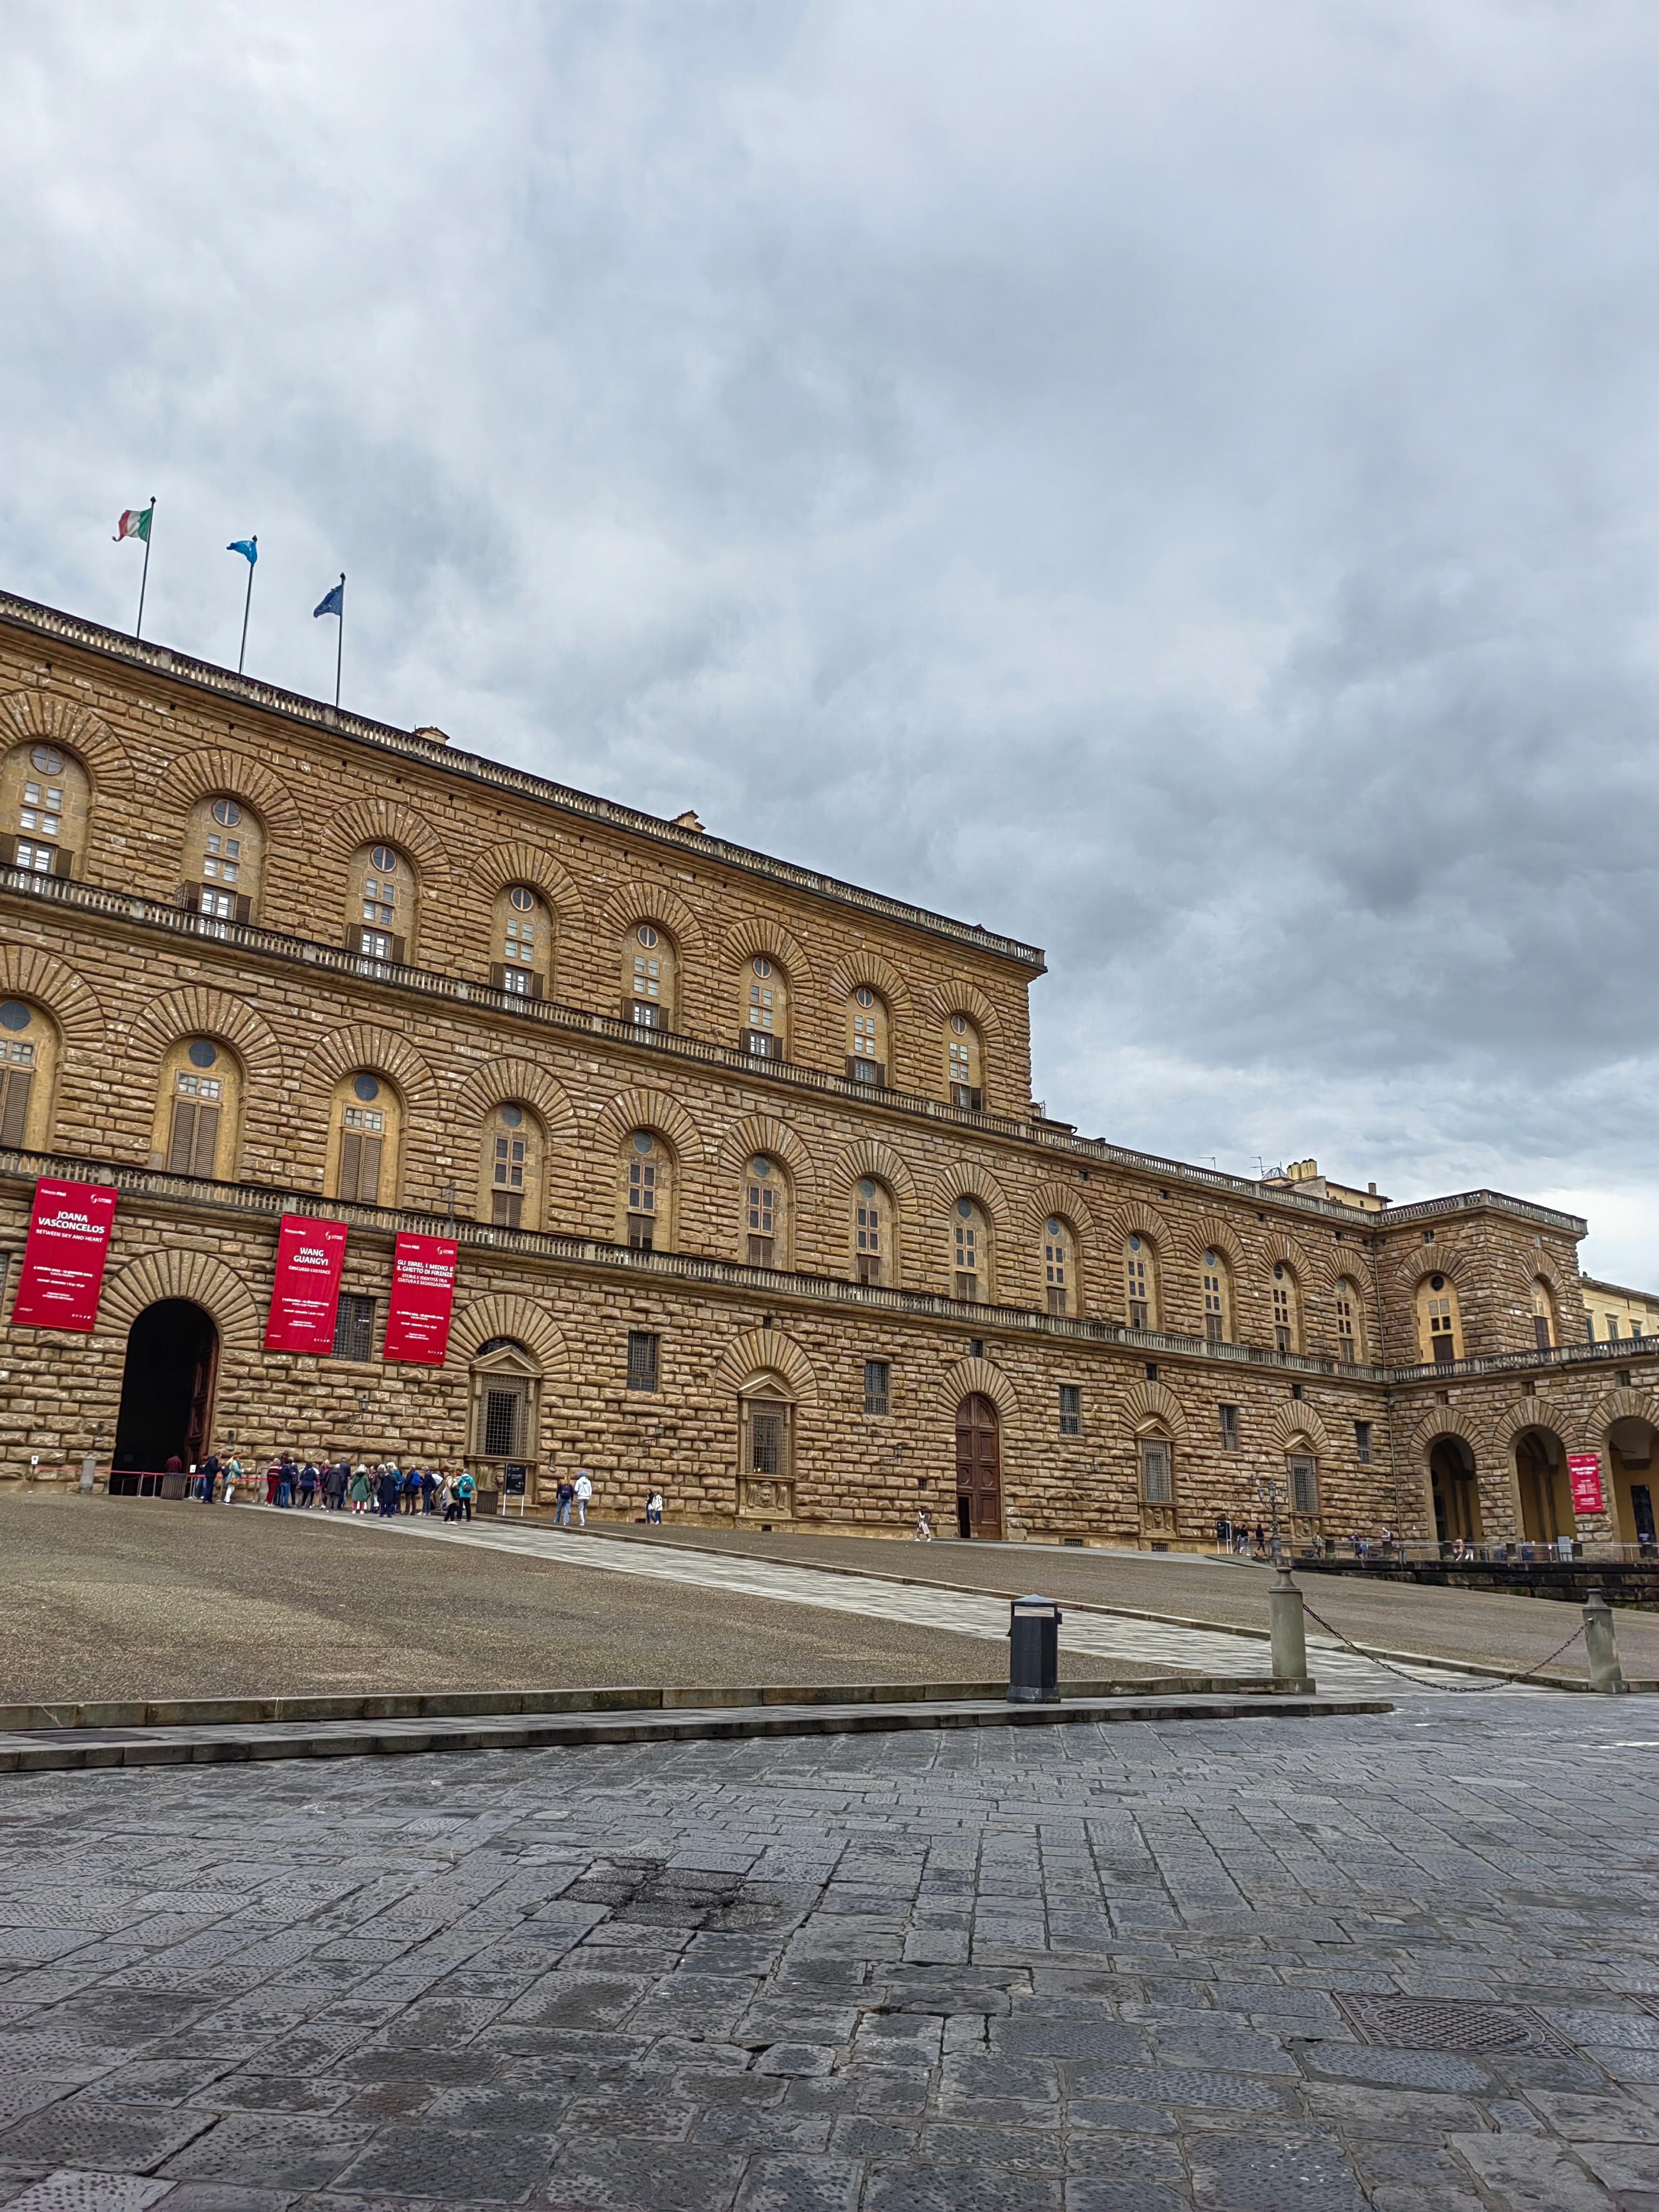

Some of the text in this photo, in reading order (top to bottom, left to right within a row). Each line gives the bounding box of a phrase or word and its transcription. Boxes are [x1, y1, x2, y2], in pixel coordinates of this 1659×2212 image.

[57, 1211, 88, 1223] JOANA
[38, 1217, 105, 1233] VASCONCELOS
[36, 1229, 61, 1237] BETWEEN
[300, 1247, 324, 1257] WANG
[293, 1255, 328, 1266] GUANGYI
